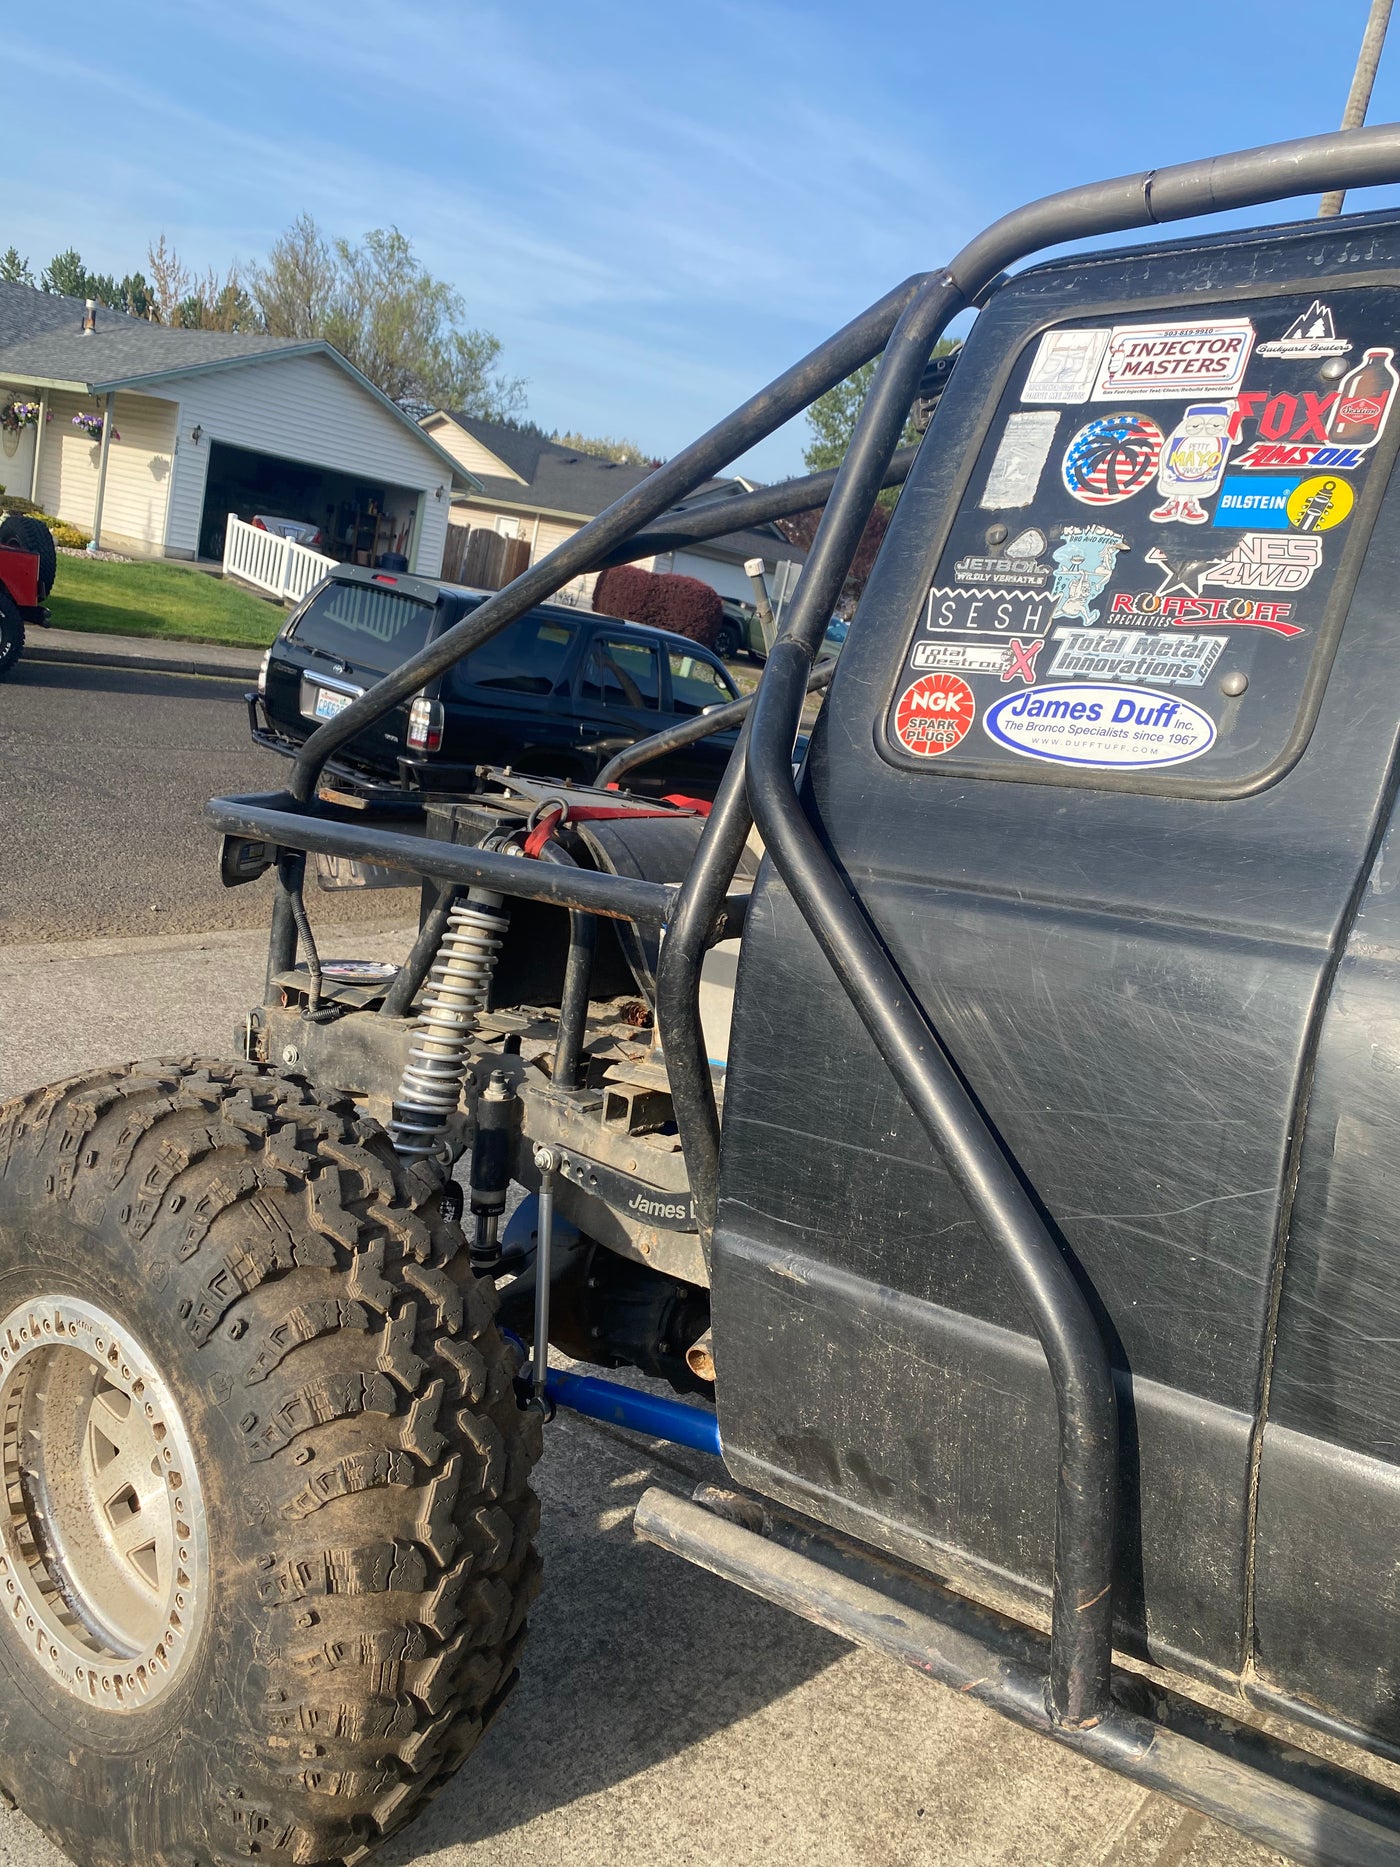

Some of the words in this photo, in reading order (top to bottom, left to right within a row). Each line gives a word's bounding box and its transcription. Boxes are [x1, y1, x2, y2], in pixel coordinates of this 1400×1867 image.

[1126, 338, 1242, 358] INJECTOR
[1257, 344, 1307, 354] Backyard
[1309, 343, 1350, 352] Beaters
[1120, 358, 1230, 376] MASTERS
[1227, 391, 1341, 441] FOX
[1342, 405, 1379, 415] Session
[1169, 451, 1222, 468] MAYO
[1238, 444, 1363, 467] AMSOIL
[1220, 495, 1286, 510] BILSTEIN
[957, 558, 1050, 574] JETBOIL
[1206, 562, 1310, 588] 4WD
[957, 572, 992, 581] WILDLY
[993, 574, 1044, 585] VERSATILE
[938, 601, 1043, 631] SESH
[1107, 613, 1172, 628] SPECIALTIES
[921, 644, 966, 657] Total
[1066, 633, 1127, 653] Total
[1131, 637, 1210, 660] Metal
[1056, 653, 1198, 679] Innovations
[910, 691, 964, 713] NGK
[1011, 693, 1104, 722] James
[1111, 699, 1181, 728] Duff
[1174, 719, 1194, 731] Inc.
[909, 718, 957, 731] SPARK
[1004, 720, 1024, 731] The
[1025, 722, 1065, 733] Bronco
[1067, 724, 1130, 739] Specialists
[1132, 730, 1165, 742] since
[1168, 733, 1198, 746] 1967
[906, 730, 954, 743] PLUGS
[1031, 738, 1158, 755] WWW.DUFFTUFF.COM
[628, 1193, 686, 1220] James
